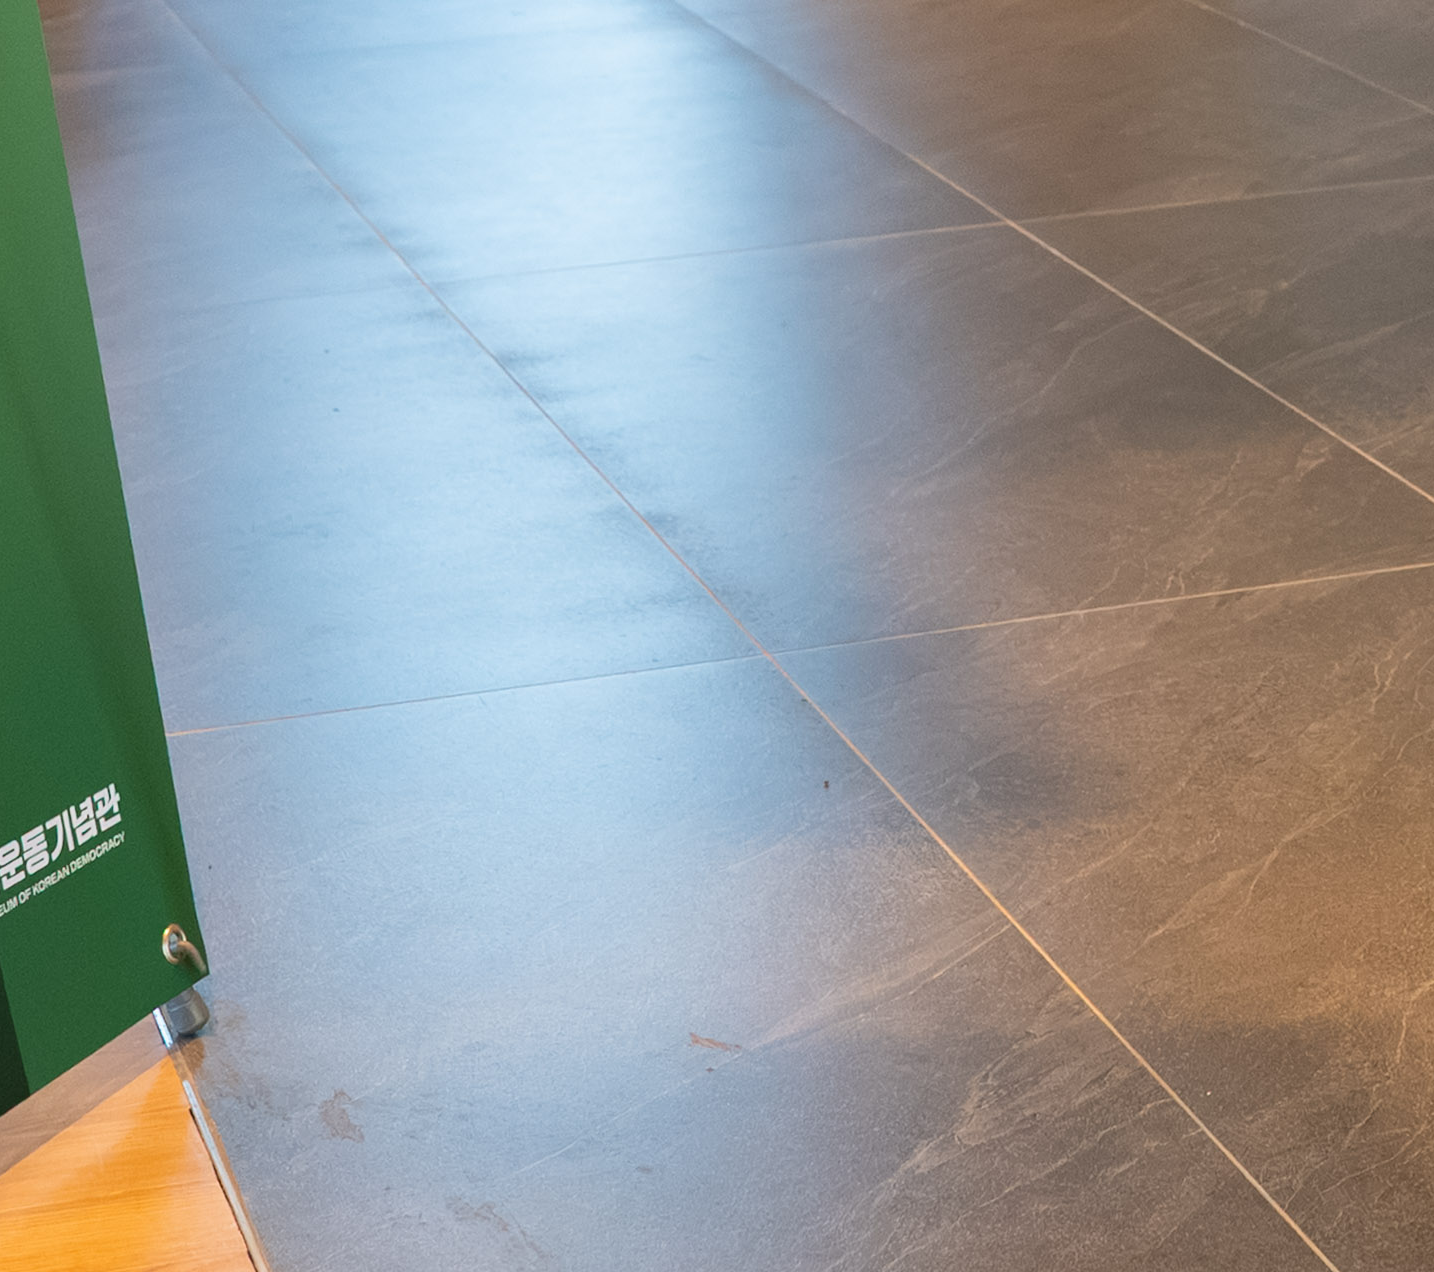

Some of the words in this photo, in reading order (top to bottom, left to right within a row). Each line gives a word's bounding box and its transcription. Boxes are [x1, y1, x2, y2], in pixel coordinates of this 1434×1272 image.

[18, 887, 32, 905] OF
[31, 865, 71, 896] KOREAN
[69, 831, 125, 873] DEMOCRACY
